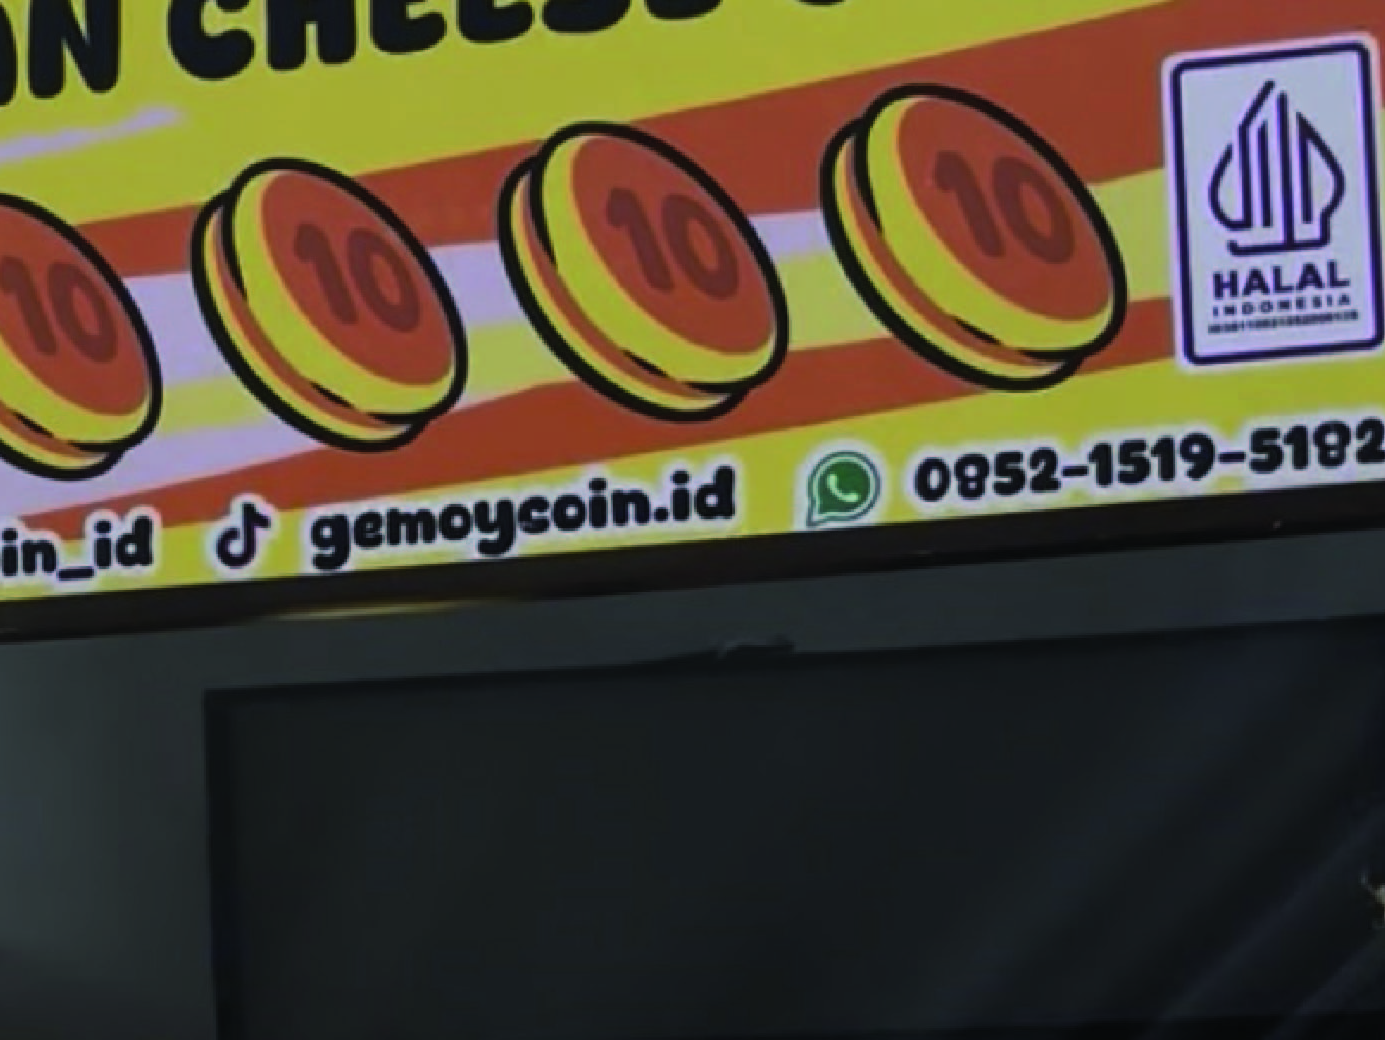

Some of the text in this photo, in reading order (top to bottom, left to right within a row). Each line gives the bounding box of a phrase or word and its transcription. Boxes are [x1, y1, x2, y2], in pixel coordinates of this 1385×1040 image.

[605, 186, 740, 301] 10
[931, 149, 1077, 265] 10
[293, 223, 423, 334] 10
[1212, 260, 1351, 301] HALAL
[914, 418, 1385, 502] 0852-1519-5182
[310, 465, 736, 572] gemoycoin.id
